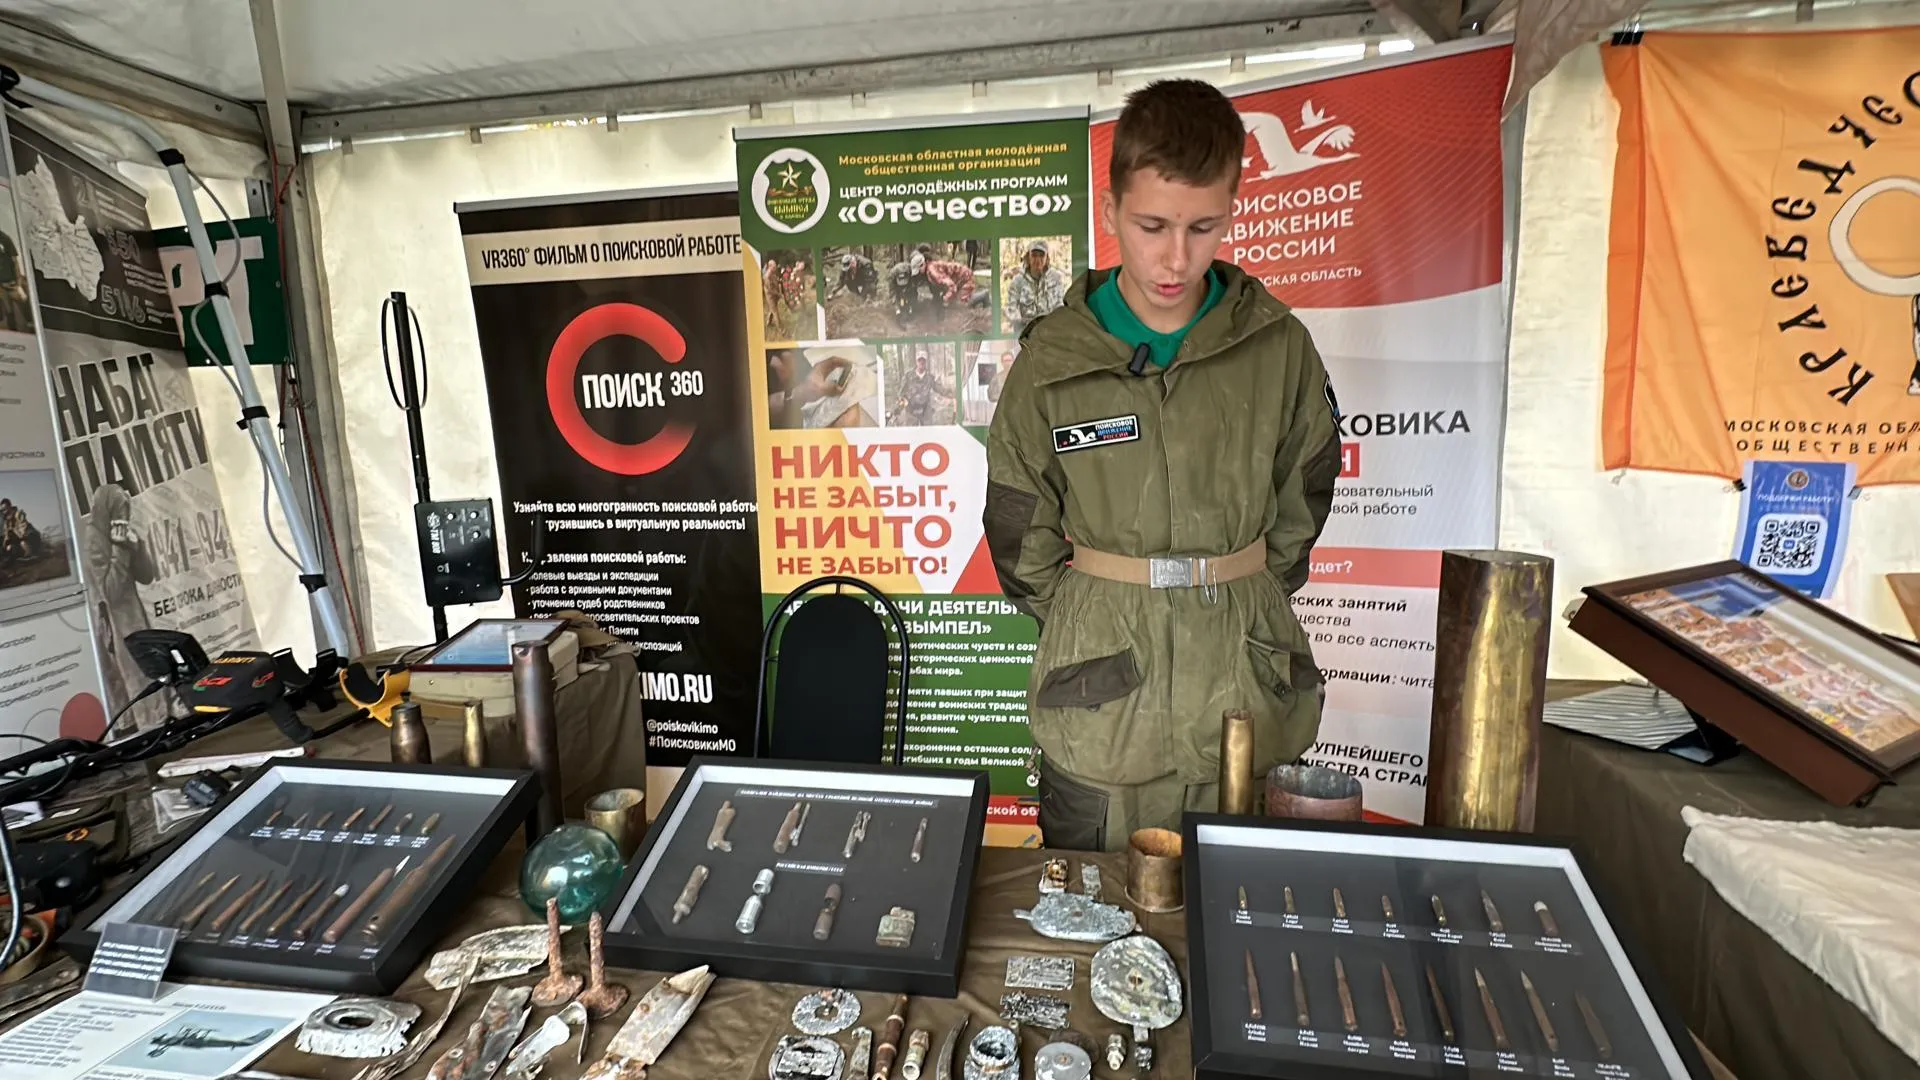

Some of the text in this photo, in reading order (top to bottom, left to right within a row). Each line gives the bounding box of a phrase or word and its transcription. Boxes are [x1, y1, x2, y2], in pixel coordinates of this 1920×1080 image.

[839, 142, 1068, 166] Московская областная молодёжная
[864, 157, 1041, 176] общественная организация
[840, 173, 1068, 200] ЦЕНТР МОЛОДЁЖНЫХ ПРОГРАММ
[838, 193, 1072, 225] «Отечество»
[534, 243, 588, 266] ФИЛЬМ
[590, 243, 600, 262] О
[603, 233, 684, 262] ПОИСКОВОЙ
[688, 233, 742, 256] РАБОТЕ
[1234, 235, 1336, 265] РОССИИ
[1259, 266, 1362, 287] СКАЯ ОБЛАСТЬ
[582, 371, 703, 408] ПОИСК 360
[51, 353, 164, 442] НАБАТ
[1725, 420, 1867, 435] МОСКОВСКАЯ
[1736, 439, 1920, 455] ОБЩЕСТВЕНН
[771, 442, 950, 479] НИКТО
[773, 485, 956, 513] НЕ ЗАБЫТ,
[513, 501, 554, 512] Узнайте
[556, 503, 576, 512] всю
[578, 502, 660, 514] многогранность
[662, 500, 717, 512] поисковой
[1363, 502, 1417, 517] работе
[606, 520, 613, 529] в
[616, 519, 680, 531] виртуальную
[683, 517, 745, 532] реальность!
[775, 515, 952, 549] НИЧТО
[590, 551, 644, 563] поисковой
[646, 551, 687, 565] работы:
[777, 556, 948, 575] НЕ ЗАБЫТО!
[567, 572, 600, 581] выезды
[610, 572, 659, 582] экспедиции
[530, 585, 559, 595] работа
[569, 585, 616, 596] архивными
[618, 586, 673, 597] документами
[532, 598, 666, 610] уточнение судеб родственников
[1338, 598, 1407, 612] занятий
[661, 617, 700, 626] проектов
[609, 626, 640, 635] Памяти
[1315, 632, 1333, 643] во
[1337, 634, 1365, 646] все
[971, 643, 1006, 652] чувств
[1008, 643, 1014, 651] и
[979, 654, 1034, 665] ценностей
[934, 668, 963, 677] мира.
[638, 671, 713, 703] IMO.RU
[934, 688, 973, 697] павших
[975, 689, 994, 699] при
[939, 702, 987, 710] воинских
[647, 719, 718, 734] @poiskovikimo
[920, 715, 966, 725] развитие
[968, 716, 1007, 725] чувства
[649, 735, 736, 751] #ПоисковикиМО
[903, 744, 961, 753] ахоронение
[964, 746, 1010, 755] останков
[954, 757, 979, 767] годы
[981, 757, 1025, 767] Великой
[1314, 741, 1424, 768] УПНЕЙШЕГО
